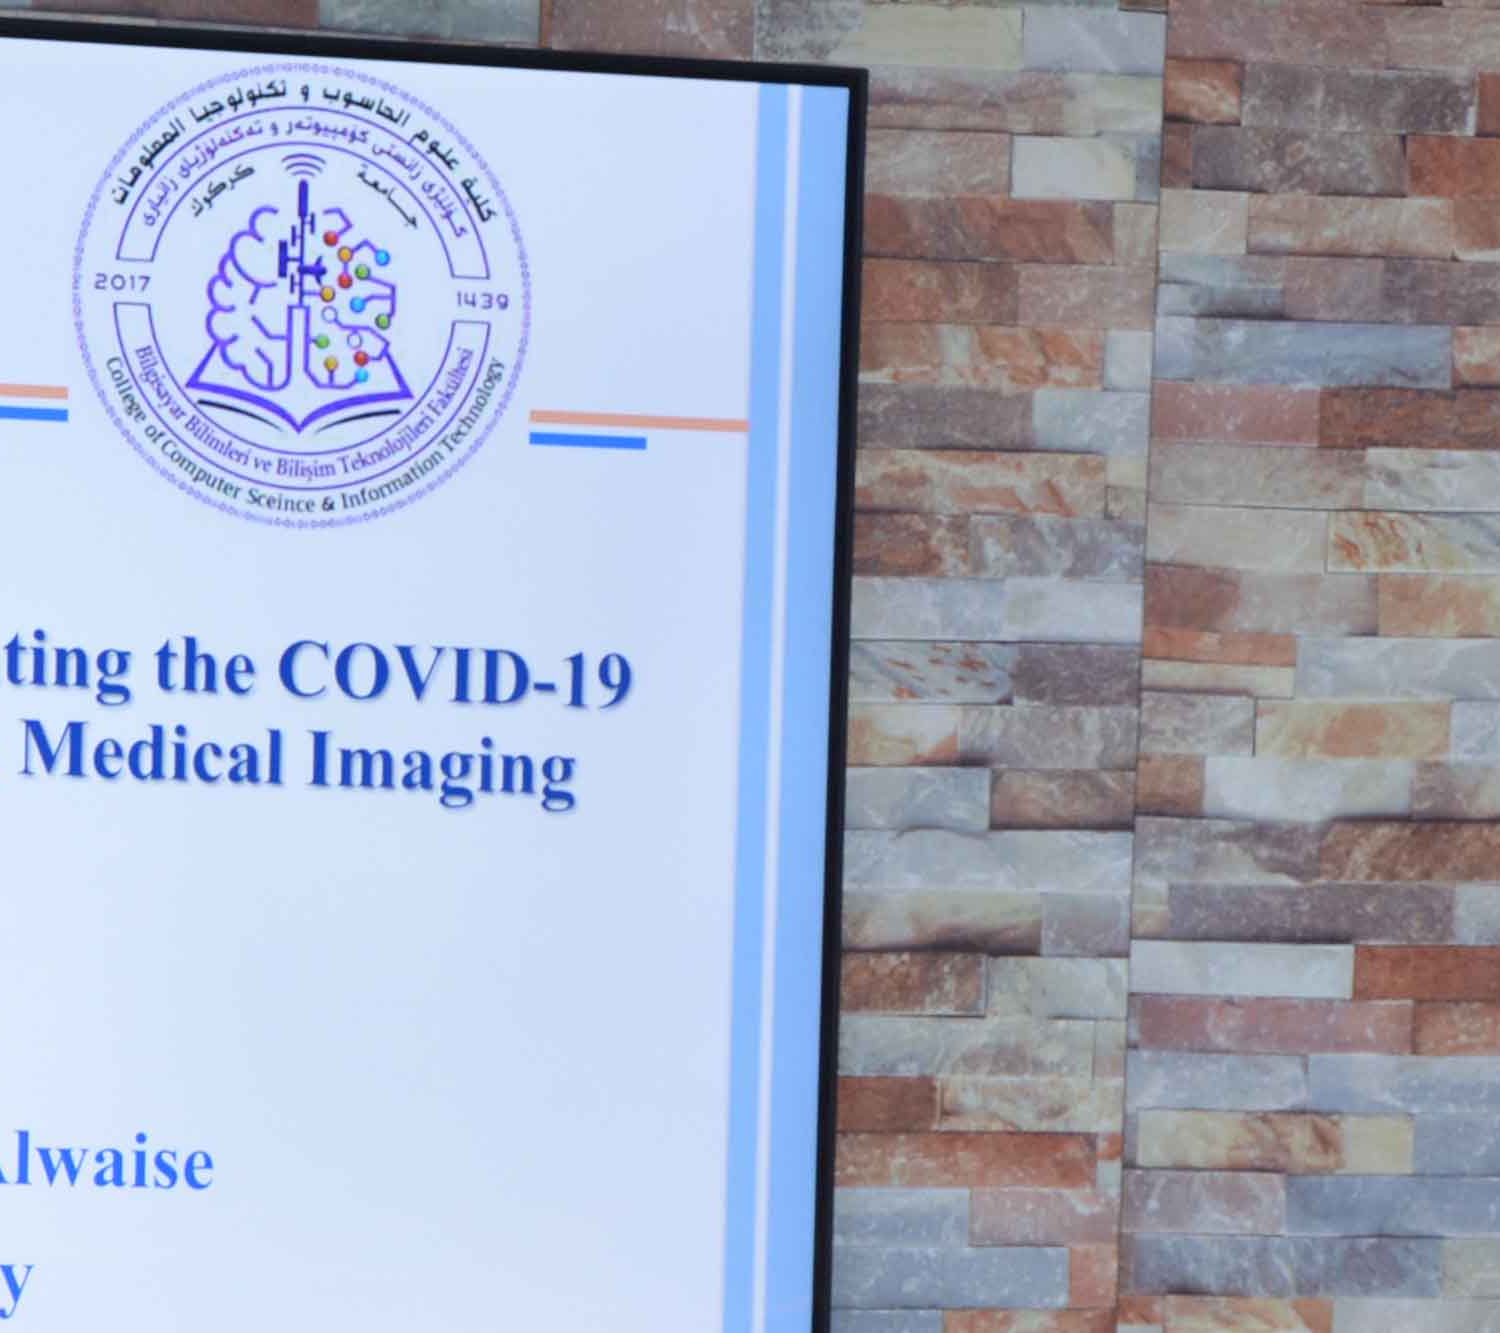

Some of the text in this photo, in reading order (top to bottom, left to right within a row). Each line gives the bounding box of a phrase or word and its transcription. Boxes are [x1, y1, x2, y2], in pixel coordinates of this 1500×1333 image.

[94, 273, 151, 291] 2017
[456, 291, 508, 310] 1439
[105, 356, 505, 513] College of Computer Sceince & Information Technology
[135, 344, 474, 482] Bilgisayar Bilimleri ve Bilişim Teknolojileri Fakültesi
[154, 635, 257, 697] the
[279, 639, 633, 710] COVID-19
[21, 719, 283, 787] Medical
[309, 730, 577, 812] Imaging
